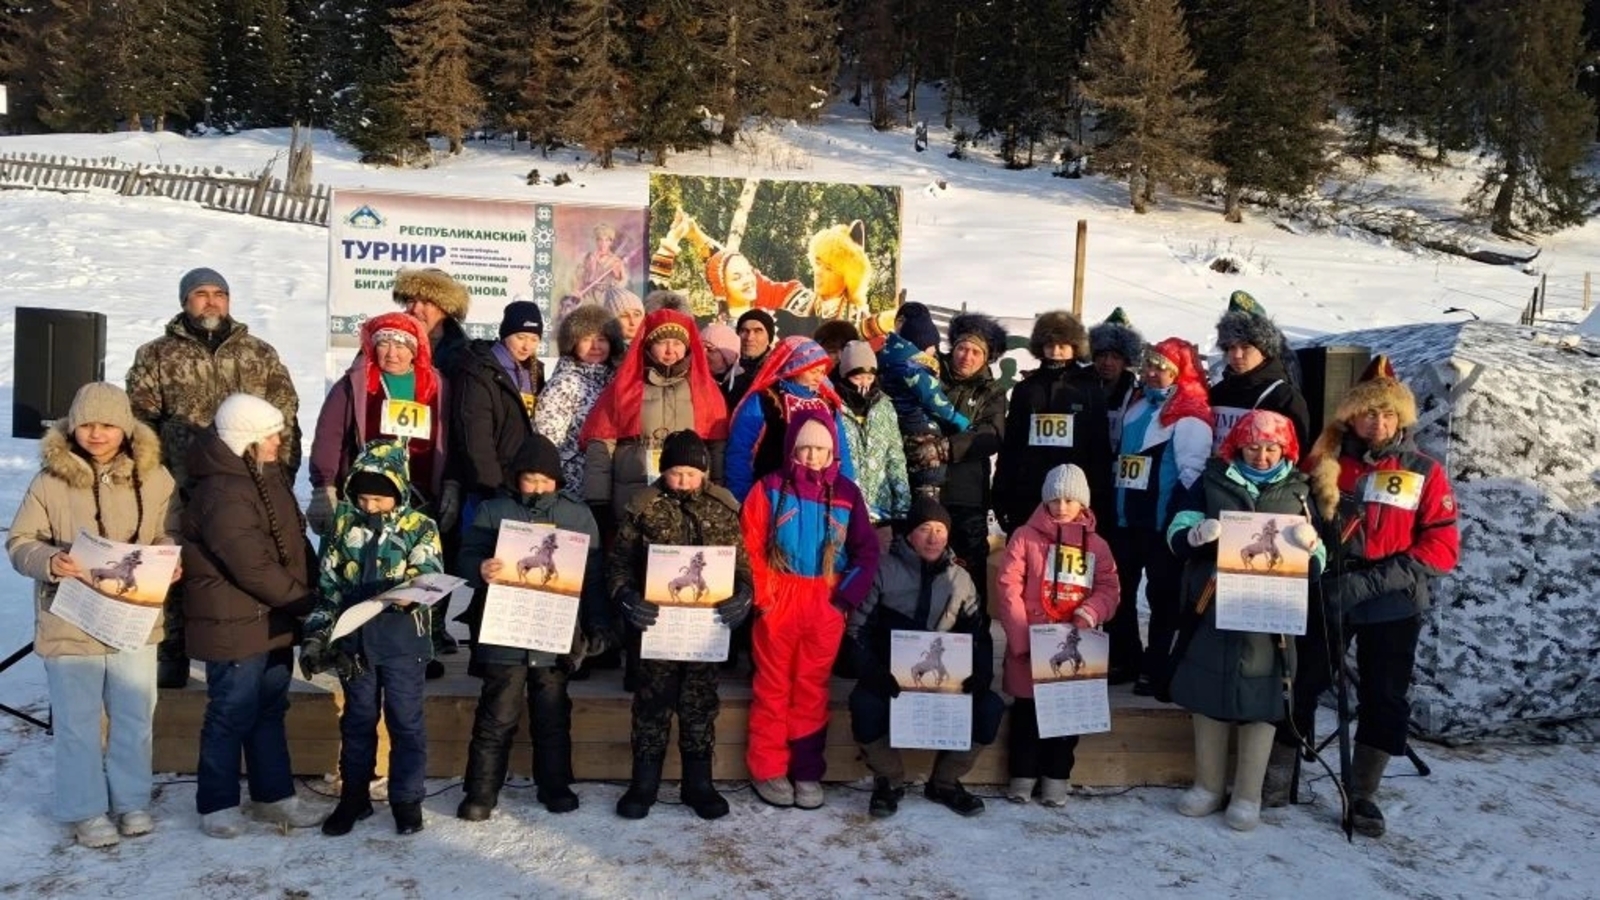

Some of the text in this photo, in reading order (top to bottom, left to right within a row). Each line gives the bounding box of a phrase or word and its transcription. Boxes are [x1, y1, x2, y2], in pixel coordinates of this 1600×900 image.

[399, 225, 527, 242] РЕСПУБЛИКАНСКИЙ
[341, 239, 446, 264] ТУРНИР
[354, 267, 393, 276] имени
[354, 279, 508, 297] БИГАР АНОВА
[397, 406, 418, 428] 61
[1035, 419, 1067, 438] 108
[1386, 475, 1403, 495] 8
